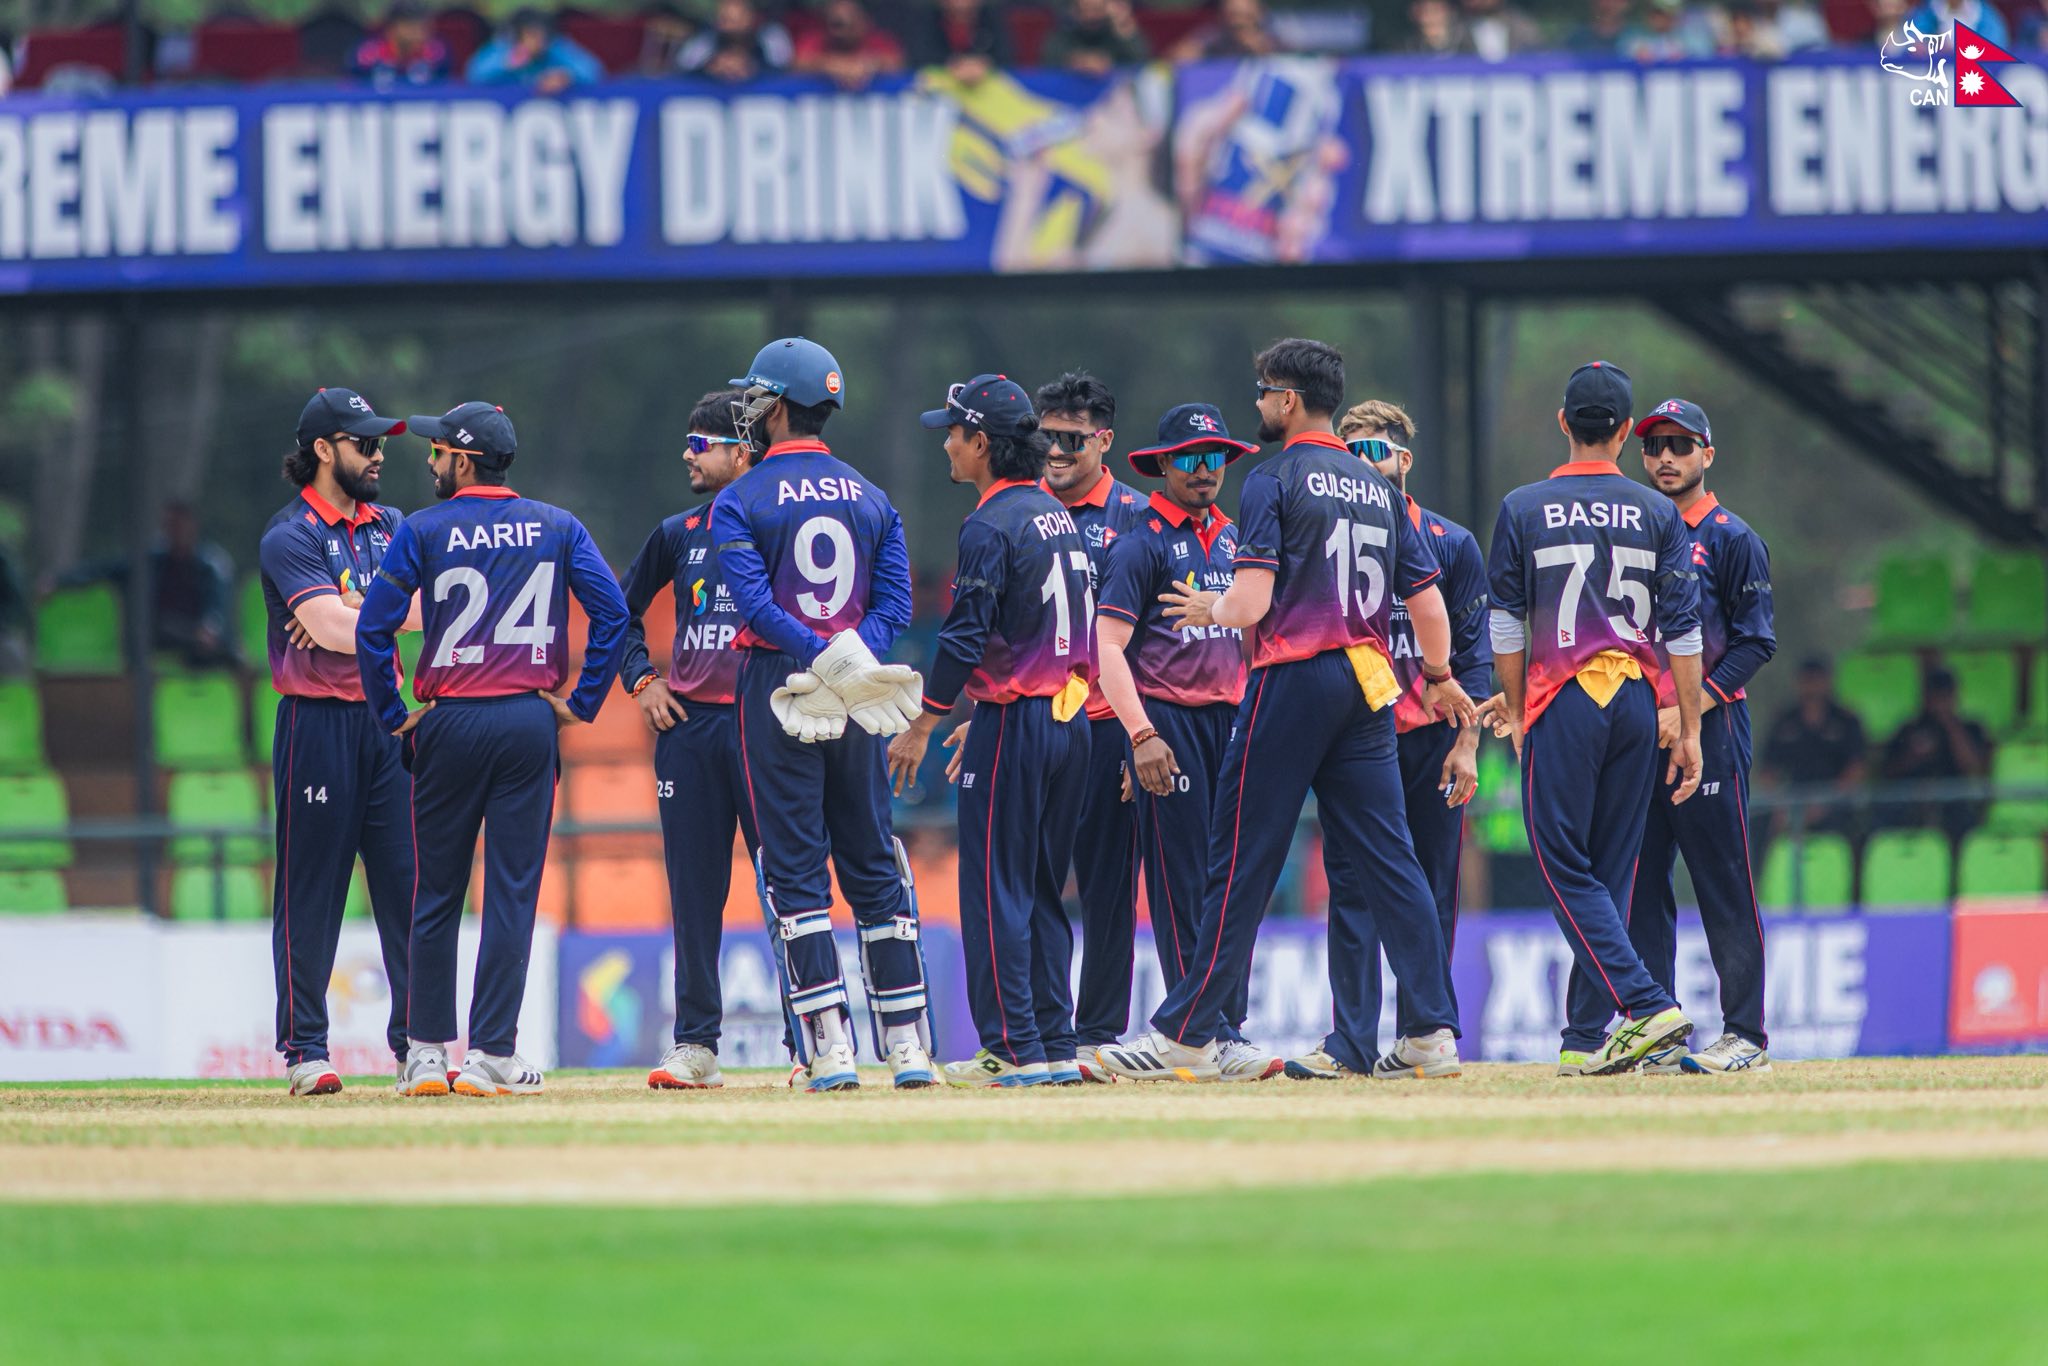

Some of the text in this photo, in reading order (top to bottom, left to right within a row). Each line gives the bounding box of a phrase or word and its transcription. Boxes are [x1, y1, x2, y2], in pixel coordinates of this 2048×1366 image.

[263, 99, 639, 254] ENERGY
[660, 94, 968, 247] DRINK
[1363, 70, 1750, 225] XTREME
[447, 522, 542, 553] AARIF
[778, 477, 863, 506] AASIF
[1307, 472, 1391, 511] GULSHAN
[1543, 502, 1643, 531] BASIR
[431, 561, 556, 669] 24
[794, 516, 856, 620] 9
[1041, 551, 1096, 657] 17
[1203, 571, 1236, 587] NAAS
[1325, 518, 1389, 620] 15
[1533, 544, 1656, 649] 75
[304, 786, 328, 804] 14
